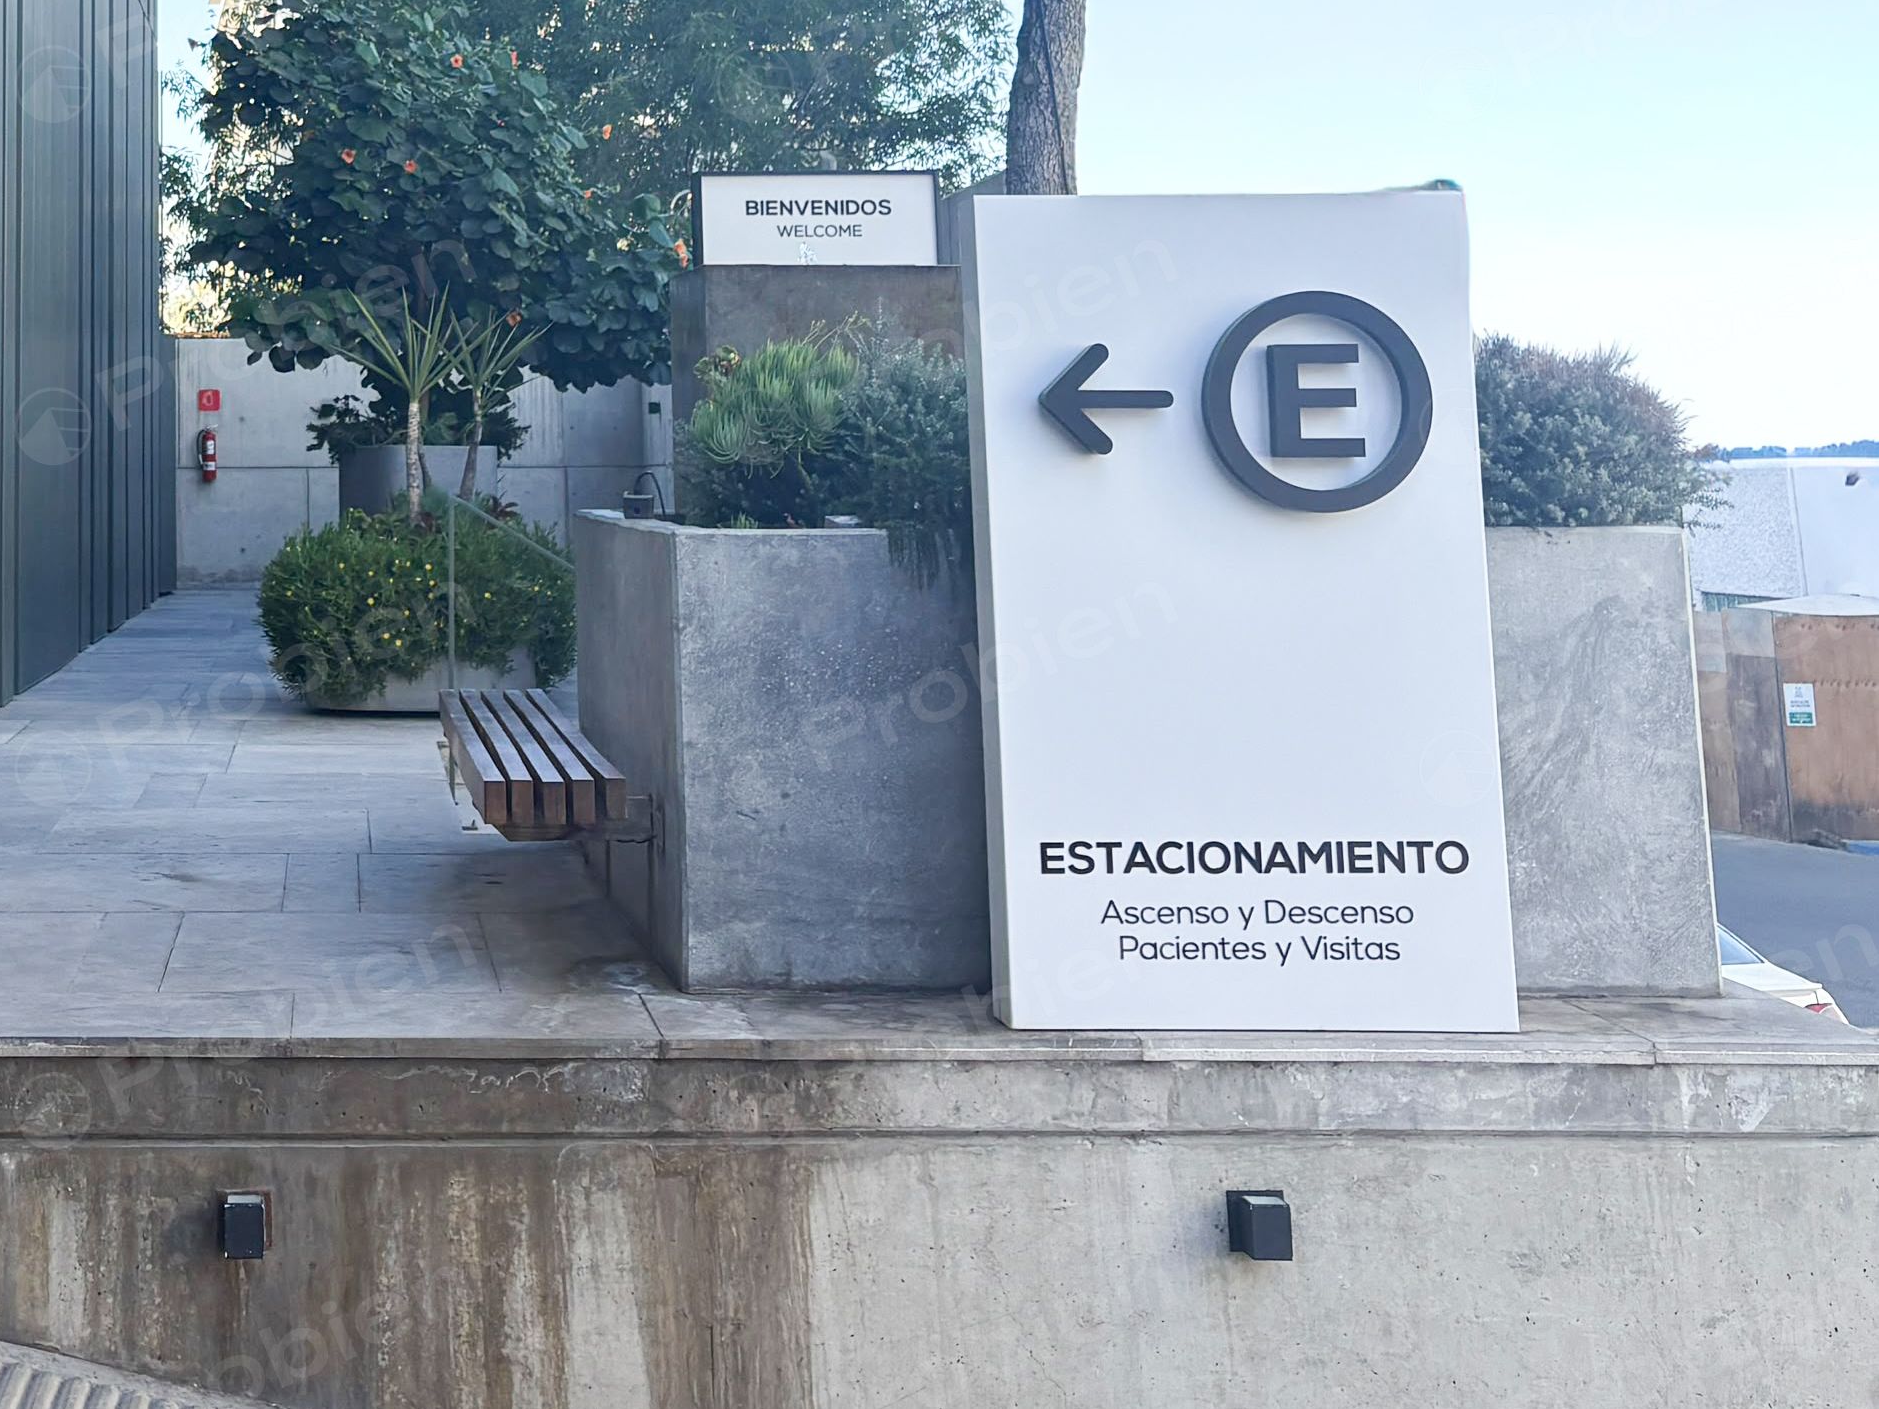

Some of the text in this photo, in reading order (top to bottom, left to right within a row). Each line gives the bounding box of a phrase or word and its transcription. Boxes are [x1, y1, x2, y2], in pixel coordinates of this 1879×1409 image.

[745, 198, 892, 216] BIENVENIDOS
[776, 224, 863, 238] WELCOME
[1266, 344, 1366, 458] E
[1039, 840, 1470, 875] ESTACIONAMIENTO
[1100, 899, 1414, 931] Ascenso y Descenso
[1119, 935, 1401, 967] Pacientes y Visitas
